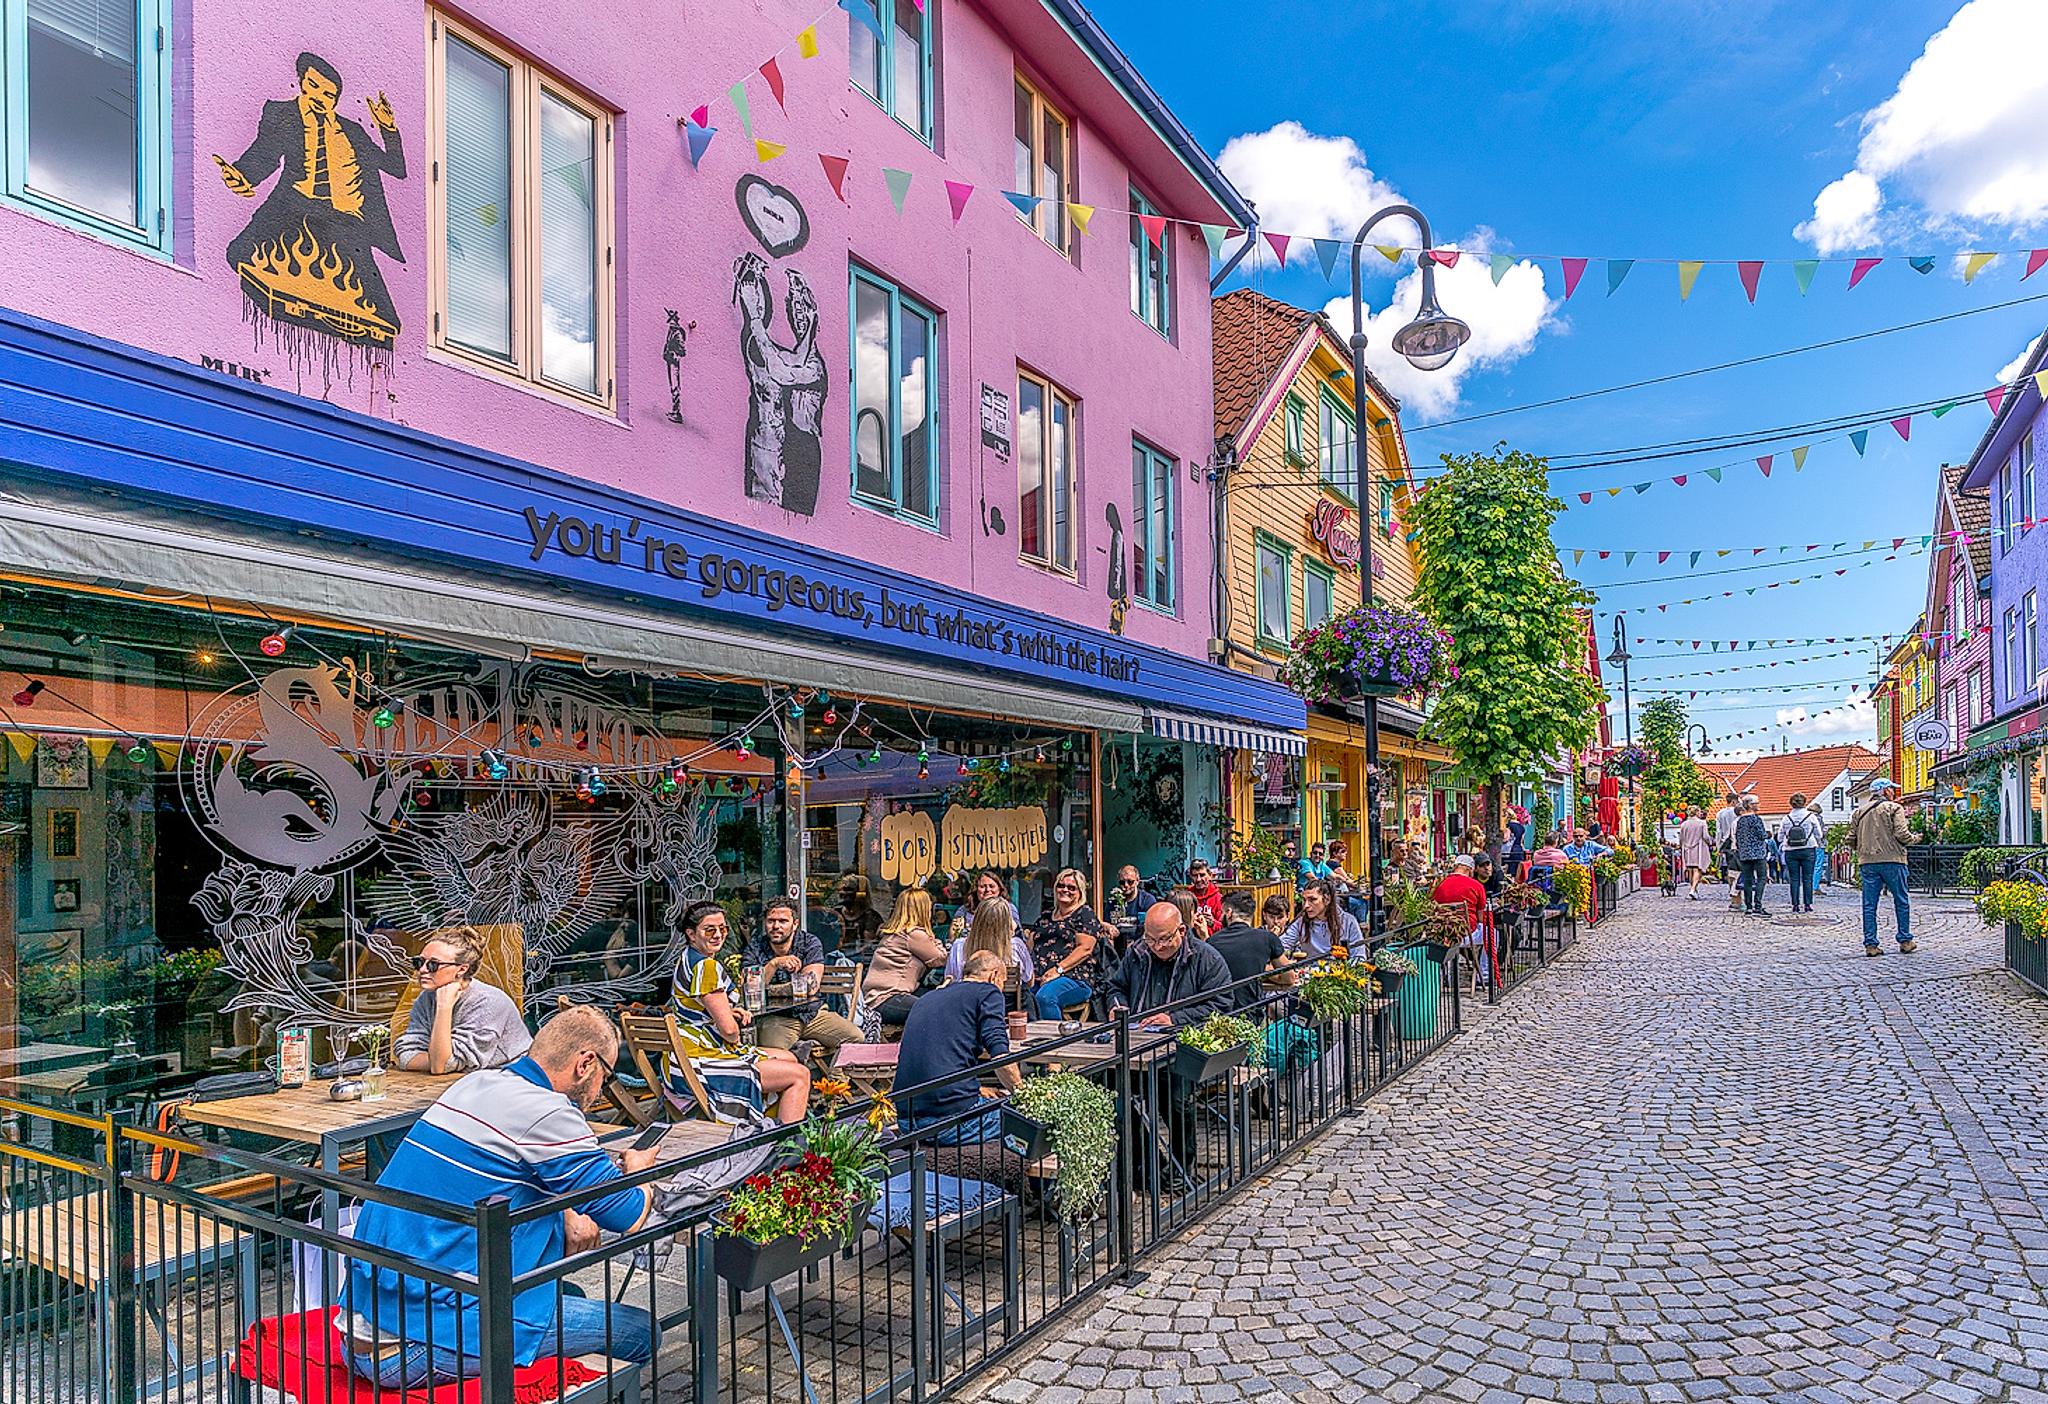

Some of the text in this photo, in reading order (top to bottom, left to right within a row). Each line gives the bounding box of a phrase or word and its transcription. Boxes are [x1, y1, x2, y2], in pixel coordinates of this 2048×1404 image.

[524, 506, 1141, 682] you're gorgeous, but what's with the hair?
[884, 825, 1046, 861] BOB STYLISTER
